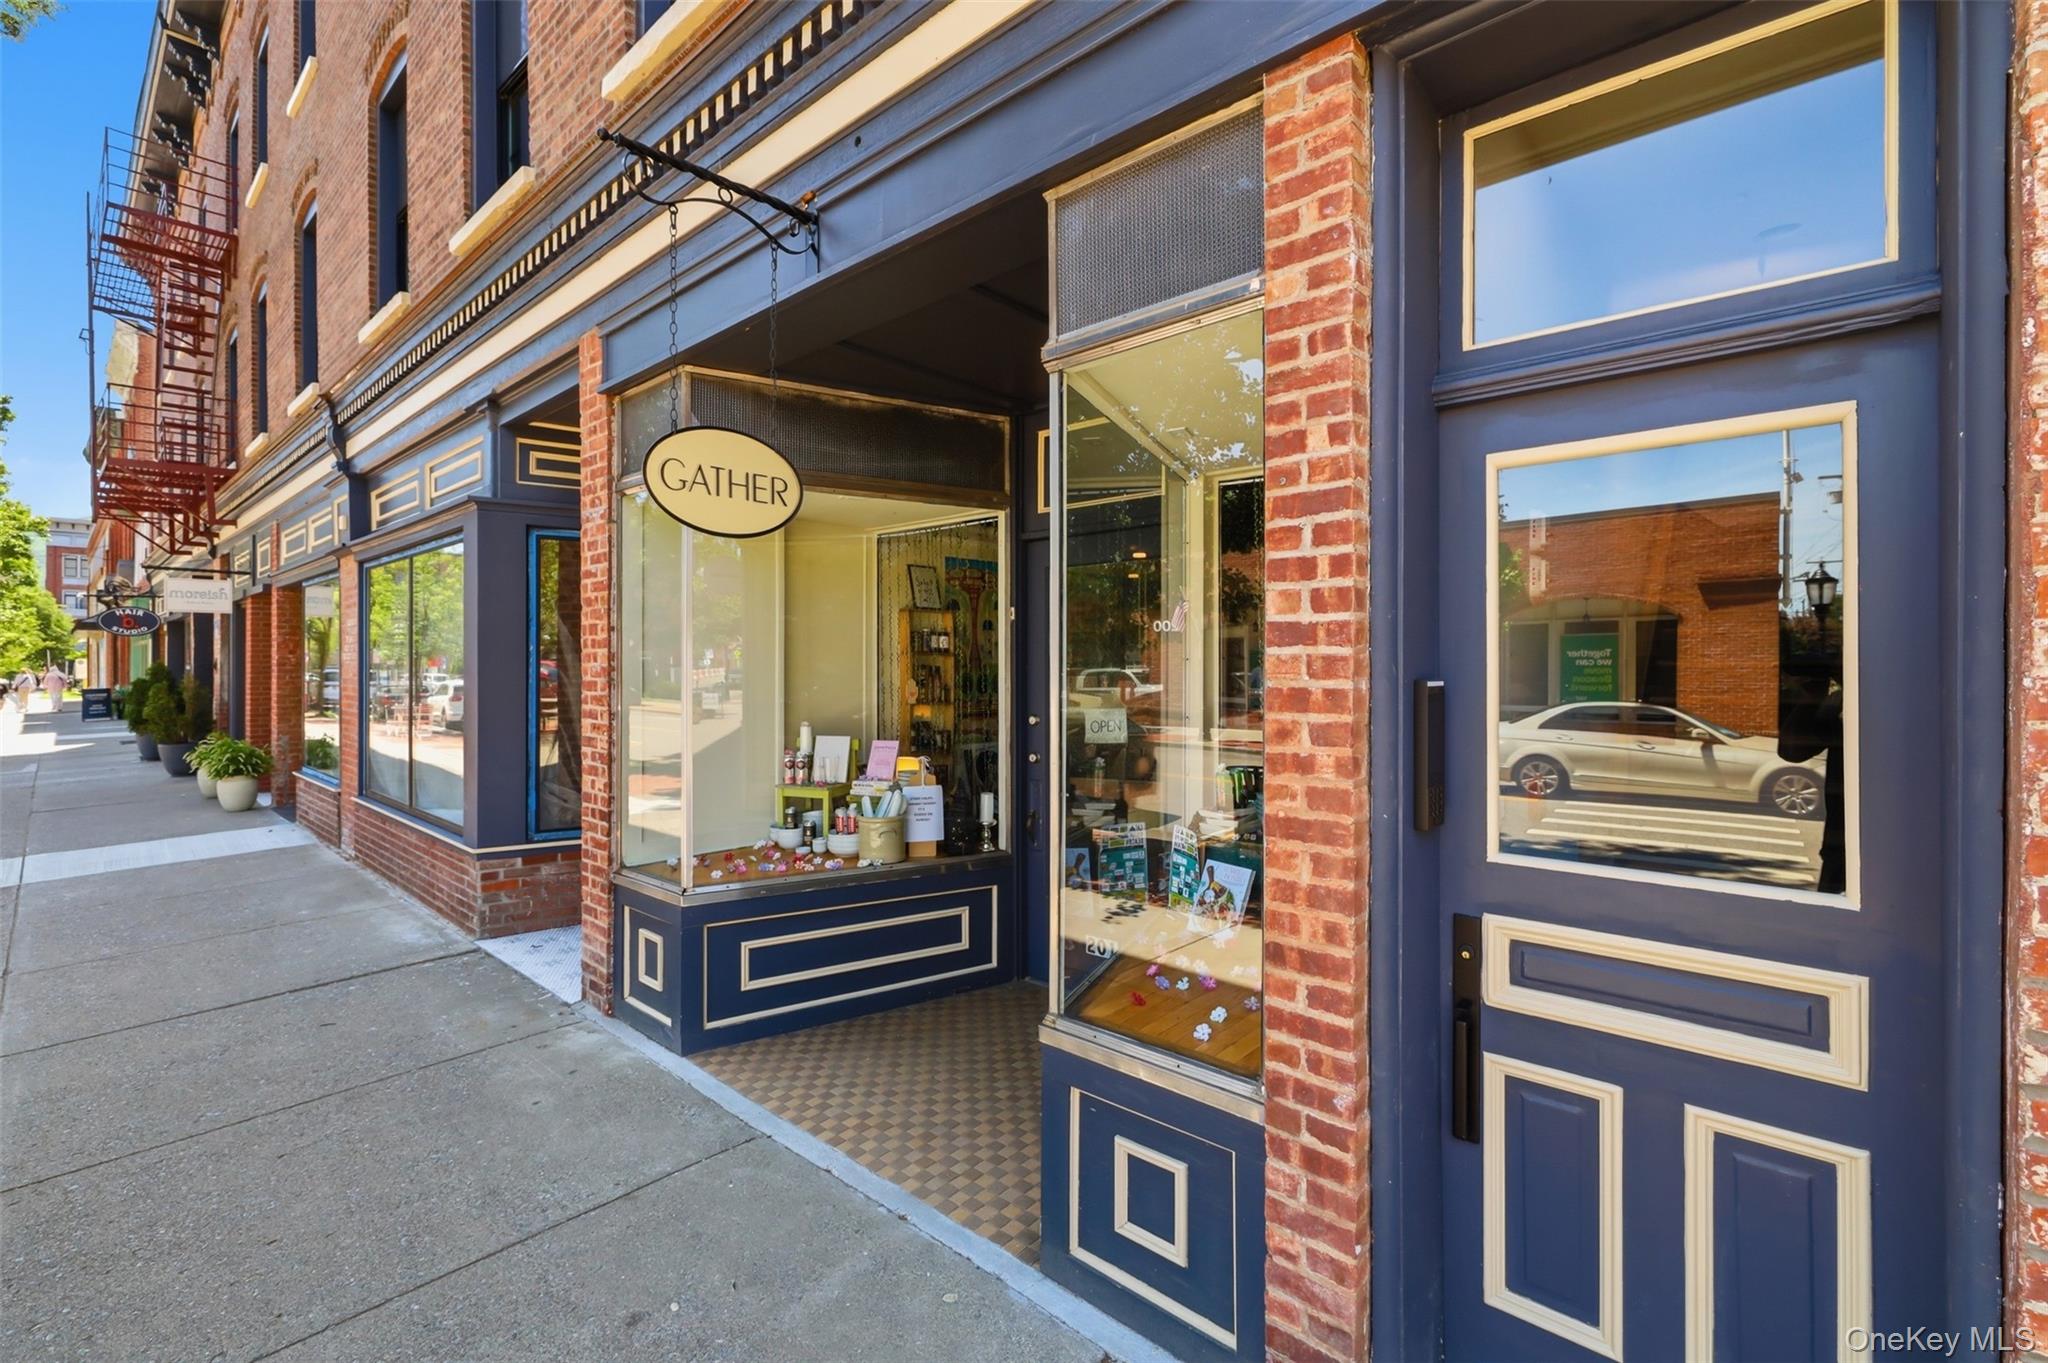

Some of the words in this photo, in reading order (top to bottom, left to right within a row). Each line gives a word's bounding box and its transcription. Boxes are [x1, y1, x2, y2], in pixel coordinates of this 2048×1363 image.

[660, 457, 789, 507] GATHER
[169, 587, 229, 601] moreish
[115, 608, 144, 617] HAIR
[112, 625, 148, 634] STUDIO
[1090, 719, 1121, 734] OPEN
